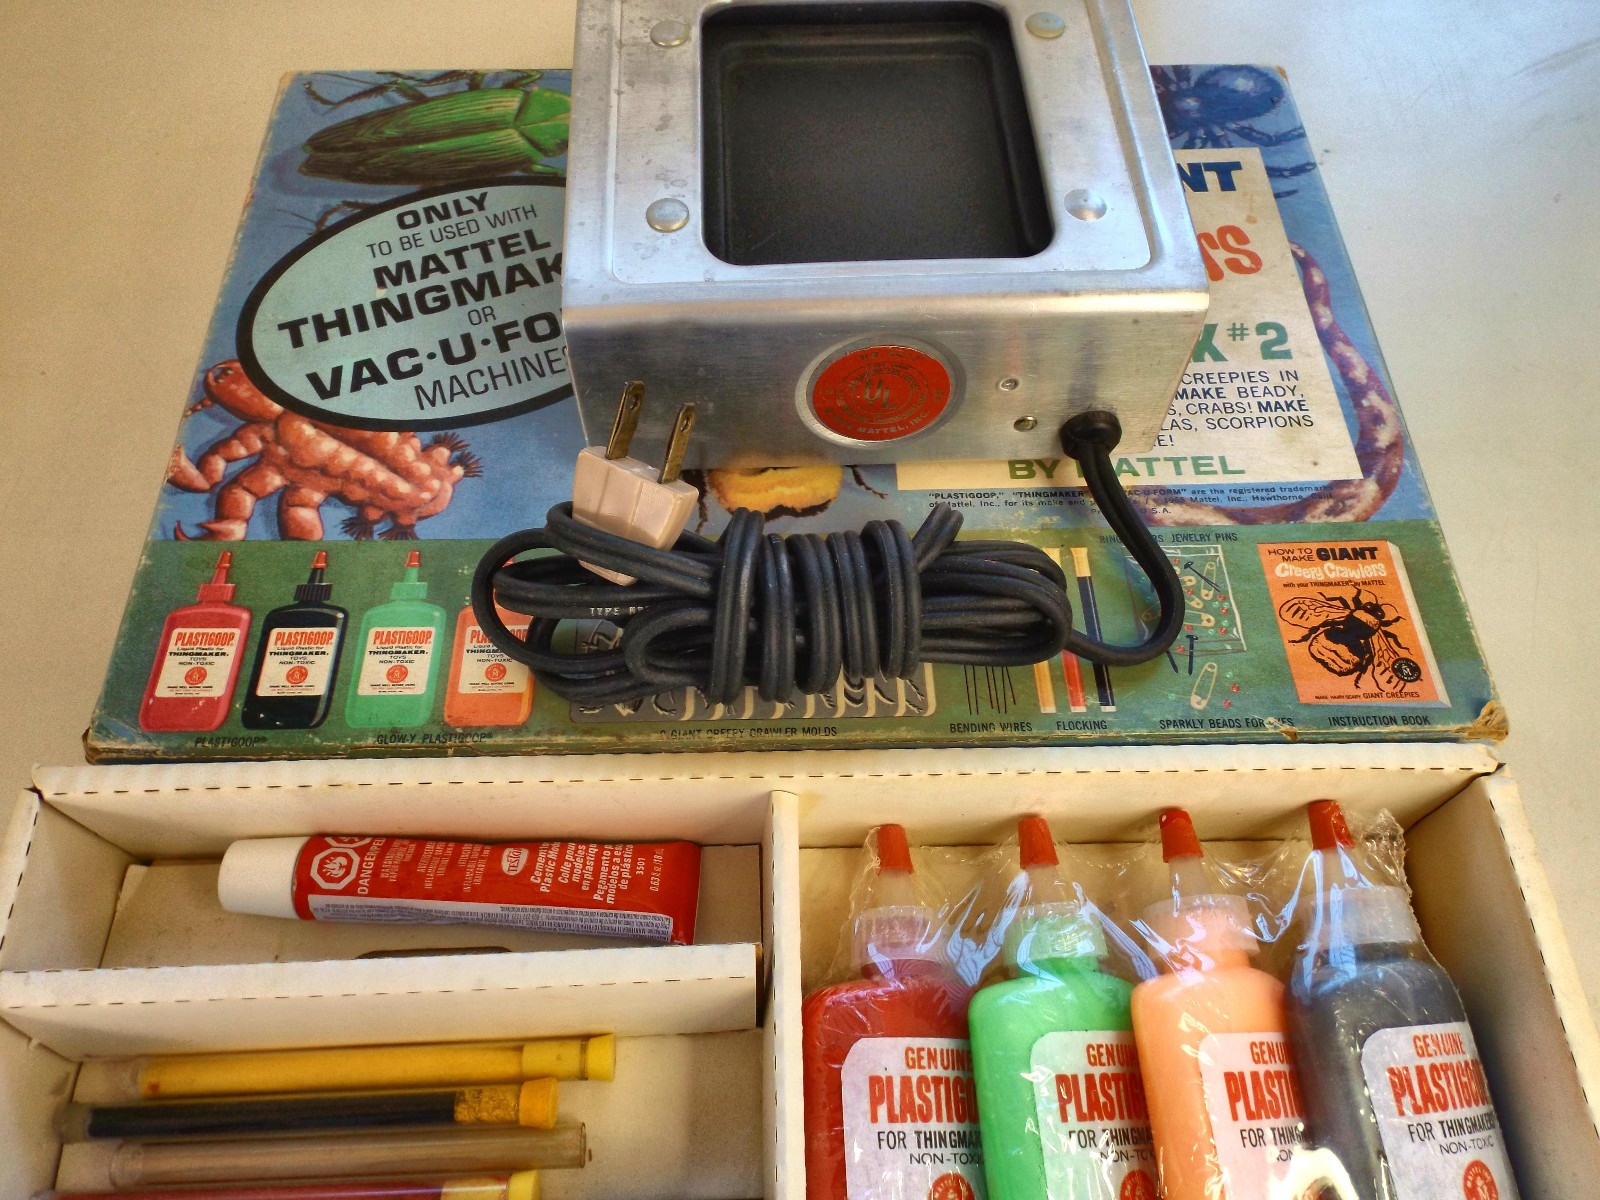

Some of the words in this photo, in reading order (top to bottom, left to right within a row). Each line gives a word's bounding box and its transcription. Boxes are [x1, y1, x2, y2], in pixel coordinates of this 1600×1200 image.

[396, 191, 488, 230] ONLY
[366, 240, 392, 258] TO
[399, 232, 424, 251] BE
[431, 218, 480, 243] USED
[488, 204, 537, 229] WITH
[373, 228, 551, 289] MATTEL
[467, 305, 496, 326] OR
[1226, 321, 1293, 360] #2
[1181, 371, 1270, 385] CREEPIES
[1279, 370, 1300, 382] IN
[864, 379, 898, 409] UL
[1175, 387, 1227, 400] MAKE
[1237, 385, 1304, 399] BEADY,
[1186, 402, 1253, 415] CRABS!
[1257, 399, 1310, 413] MAKE
[1206, 415, 1314, 430] SCORPIONS
[1008, 460, 1061, 480] BY
[1229, 486, 1276, 496] registered
[1171, 533, 1211, 543] JEWELRY
[1215, 532, 1238, 542] PINS
[1316, 547, 1378, 561] GIANT
[1275, 562, 1324, 580] Creepy
[1324, 562, 1387, 579] Crawlers
[950, 722, 995, 733] BENDING
[1000, 721, 1033, 733] WIRES
[1056, 720, 1108, 731] FLOCKING
[1159, 718, 1204, 729] SPARKLY
[1209, 718, 1241, 729] BEADS
[1245, 717, 1266, 728] FOR
[1328, 716, 1398, 727] INSTRUCTION
[1401, 715, 1431, 726] BOOK
[377, 733, 416, 745] GLOW-Y
[802, 726, 837, 737] MOLDS
[530, 846, 549, 883] Cement
[558, 861, 572, 884] Colle
[636, 857, 646, 875] 3501
[540, 861, 556, 893] Plastic
[593, 850, 611, 901] Pegamento
[606, 864, 620, 905] modelos
[618, 879, 629, 890] de
[649, 876, 661, 892] 0.63
[581, 880, 591, 891] en
[1413, 1032, 1465, 1058] GENUINE
[877, 1130, 907, 1149] FOR
[1240, 1127, 1266, 1148] FOR
[1408, 1122, 1435, 1142] FOR
